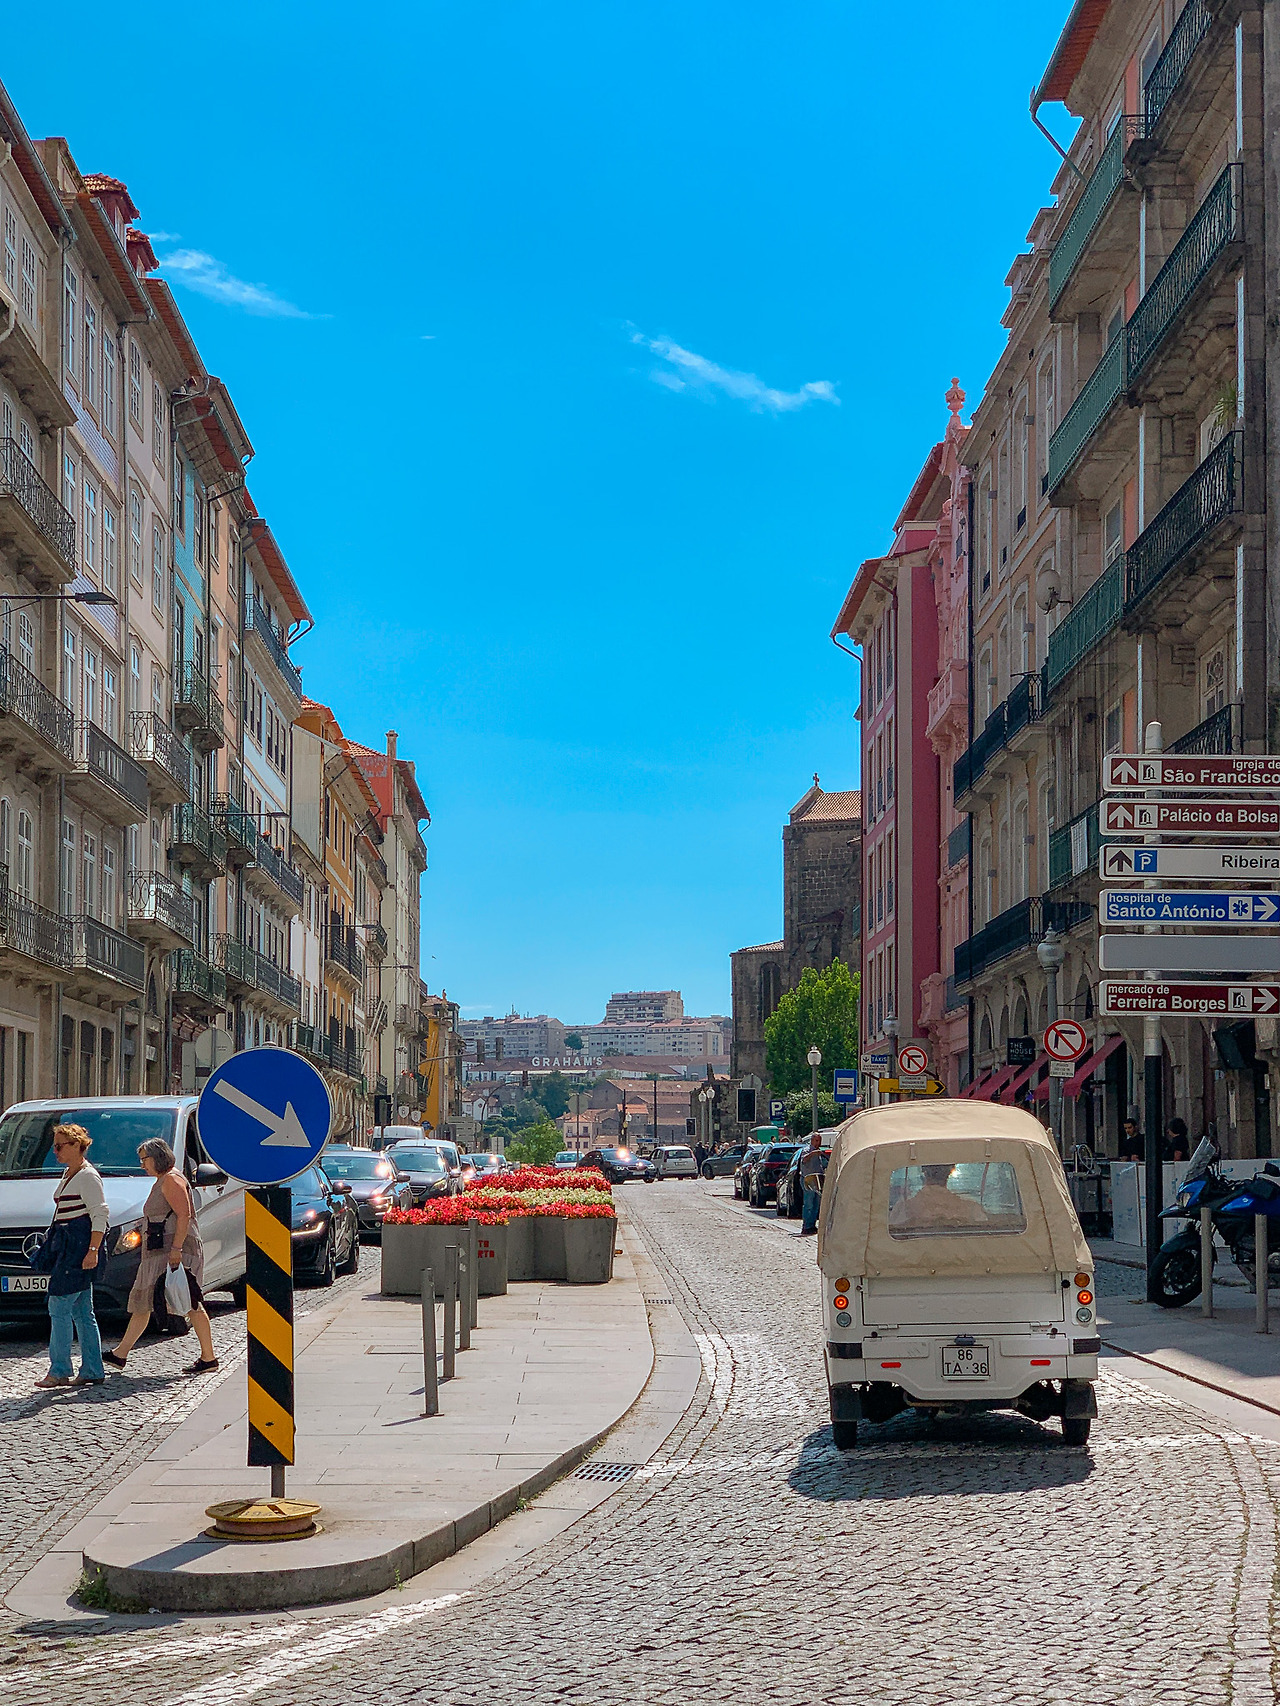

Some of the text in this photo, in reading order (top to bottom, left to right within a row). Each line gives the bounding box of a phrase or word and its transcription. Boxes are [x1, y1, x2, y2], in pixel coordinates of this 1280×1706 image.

[1232, 759, 1280, 771] igreja de
[1163, 769, 1280, 784] São Francisco
[1160, 808, 1278, 823] Palácio da Bolsa
[1221, 854, 1280, 869] Ribeira
[1108, 893, 1172, 905] hospital de
[1108, 903, 1226, 920] Santo António
[1108, 985, 1170, 996] mercado de
[1107, 995, 1226, 1013] Ferreira Borges
[532, 1056, 603, 1067] GRAHAM'S
[957, 1349, 973, 1361] 86
